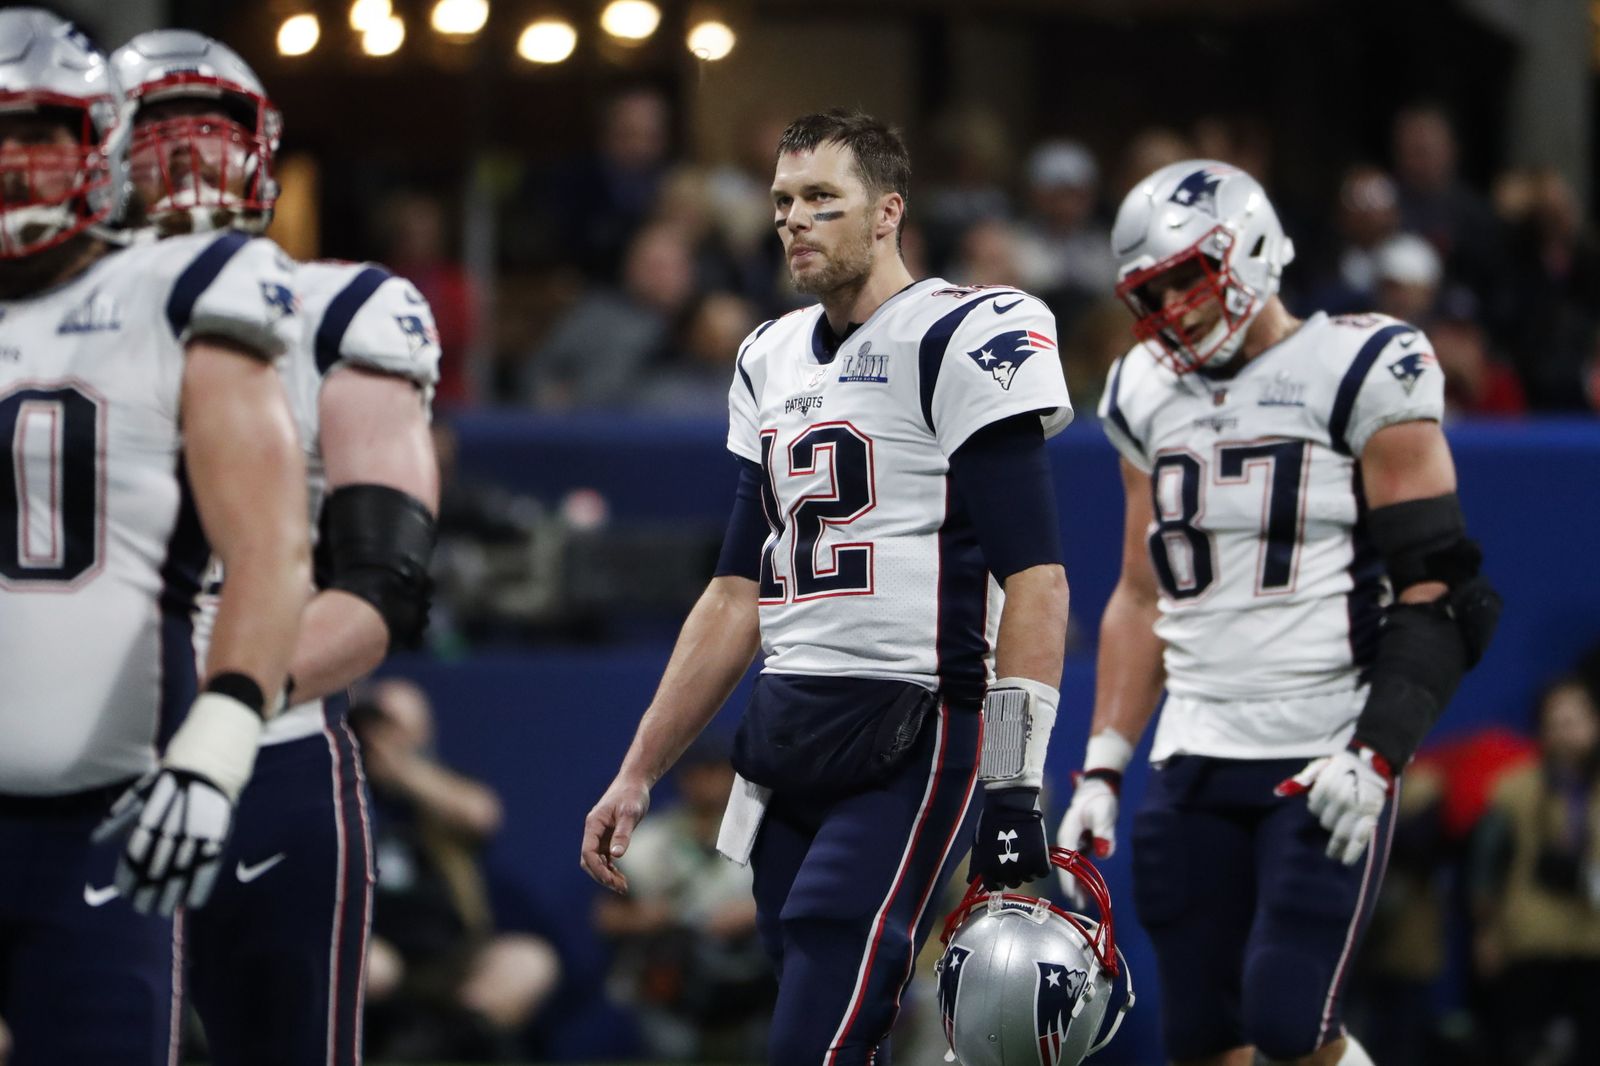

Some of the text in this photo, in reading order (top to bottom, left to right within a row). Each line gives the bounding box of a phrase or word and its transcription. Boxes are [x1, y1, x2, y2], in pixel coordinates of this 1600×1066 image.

[784, 396, 823, 414] PATRIOTS
[759, 420, 876, 605] 12
[1147, 437, 1312, 605] 87
